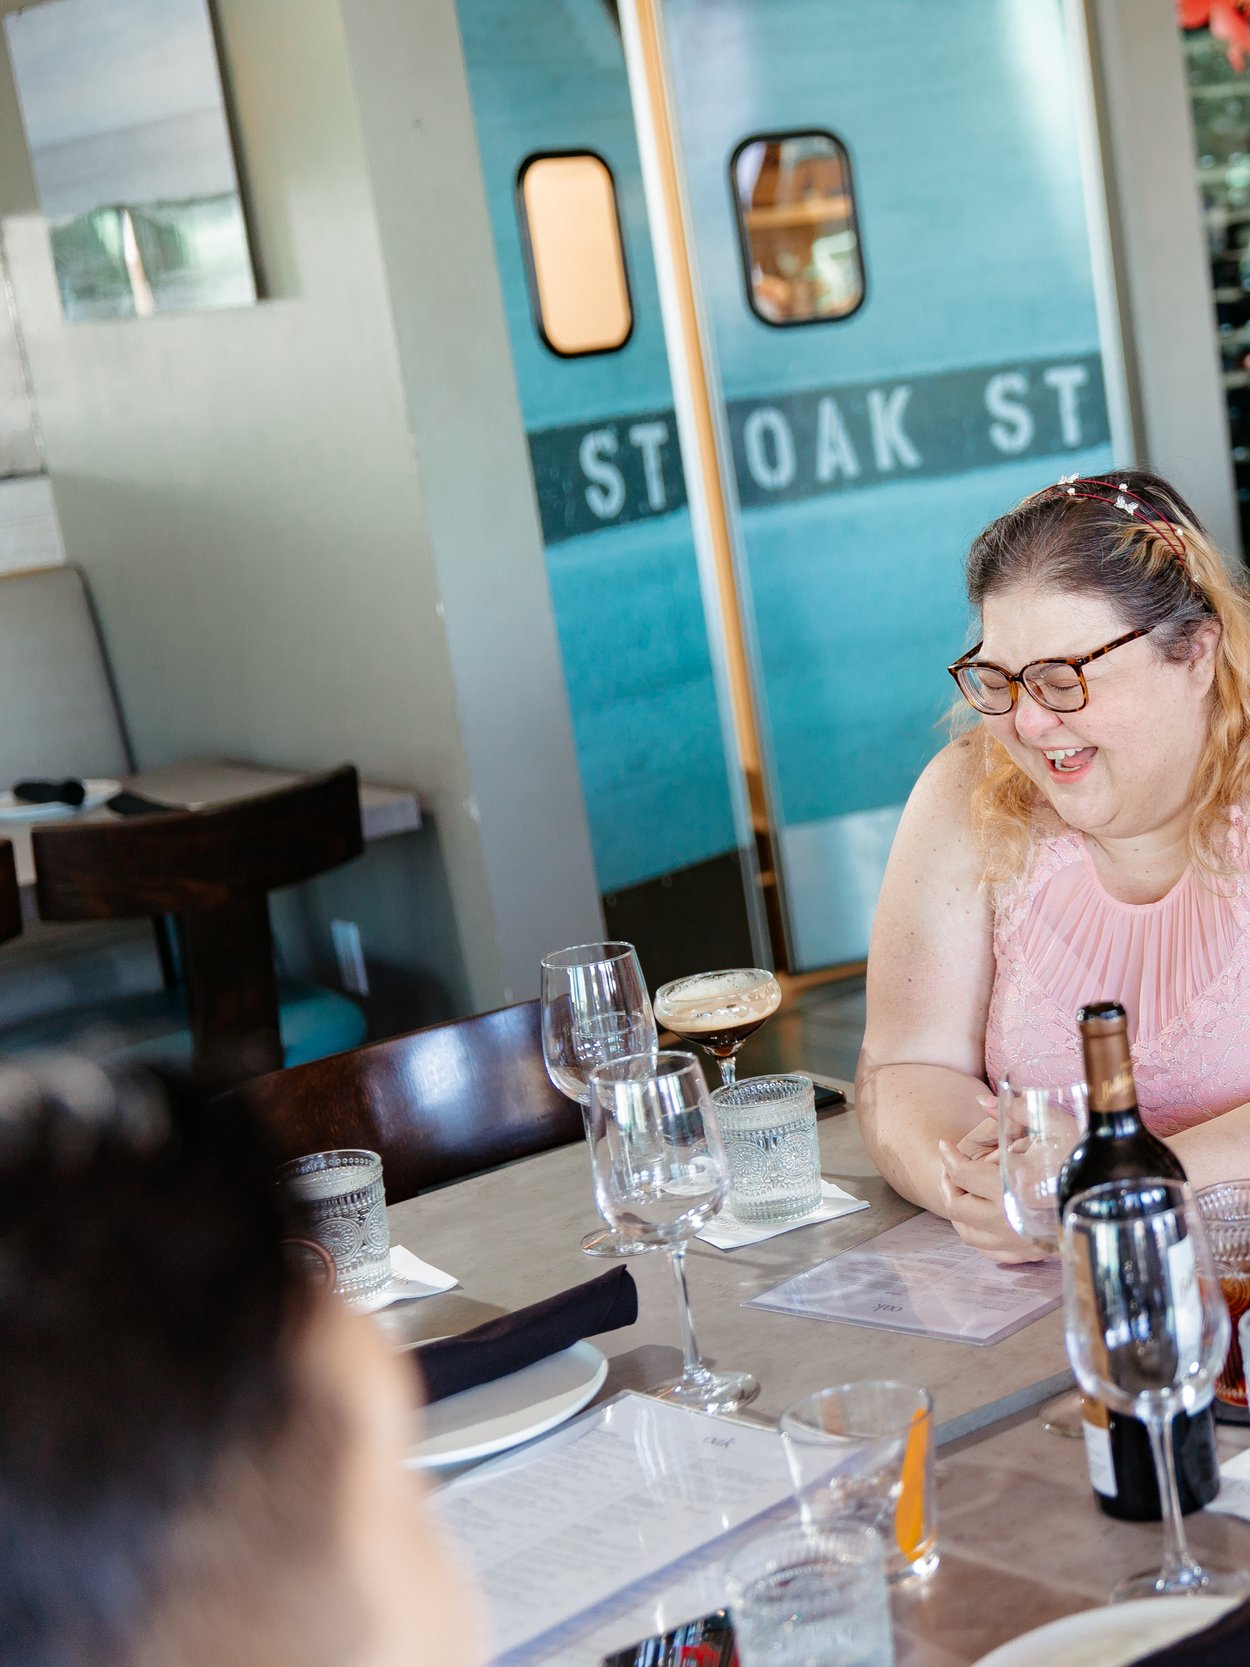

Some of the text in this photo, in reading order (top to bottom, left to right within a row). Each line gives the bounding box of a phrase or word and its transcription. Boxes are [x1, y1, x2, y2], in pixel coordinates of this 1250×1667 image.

[579, 422, 669, 519] ST
[743, 366, 1089, 491] OAK ST
